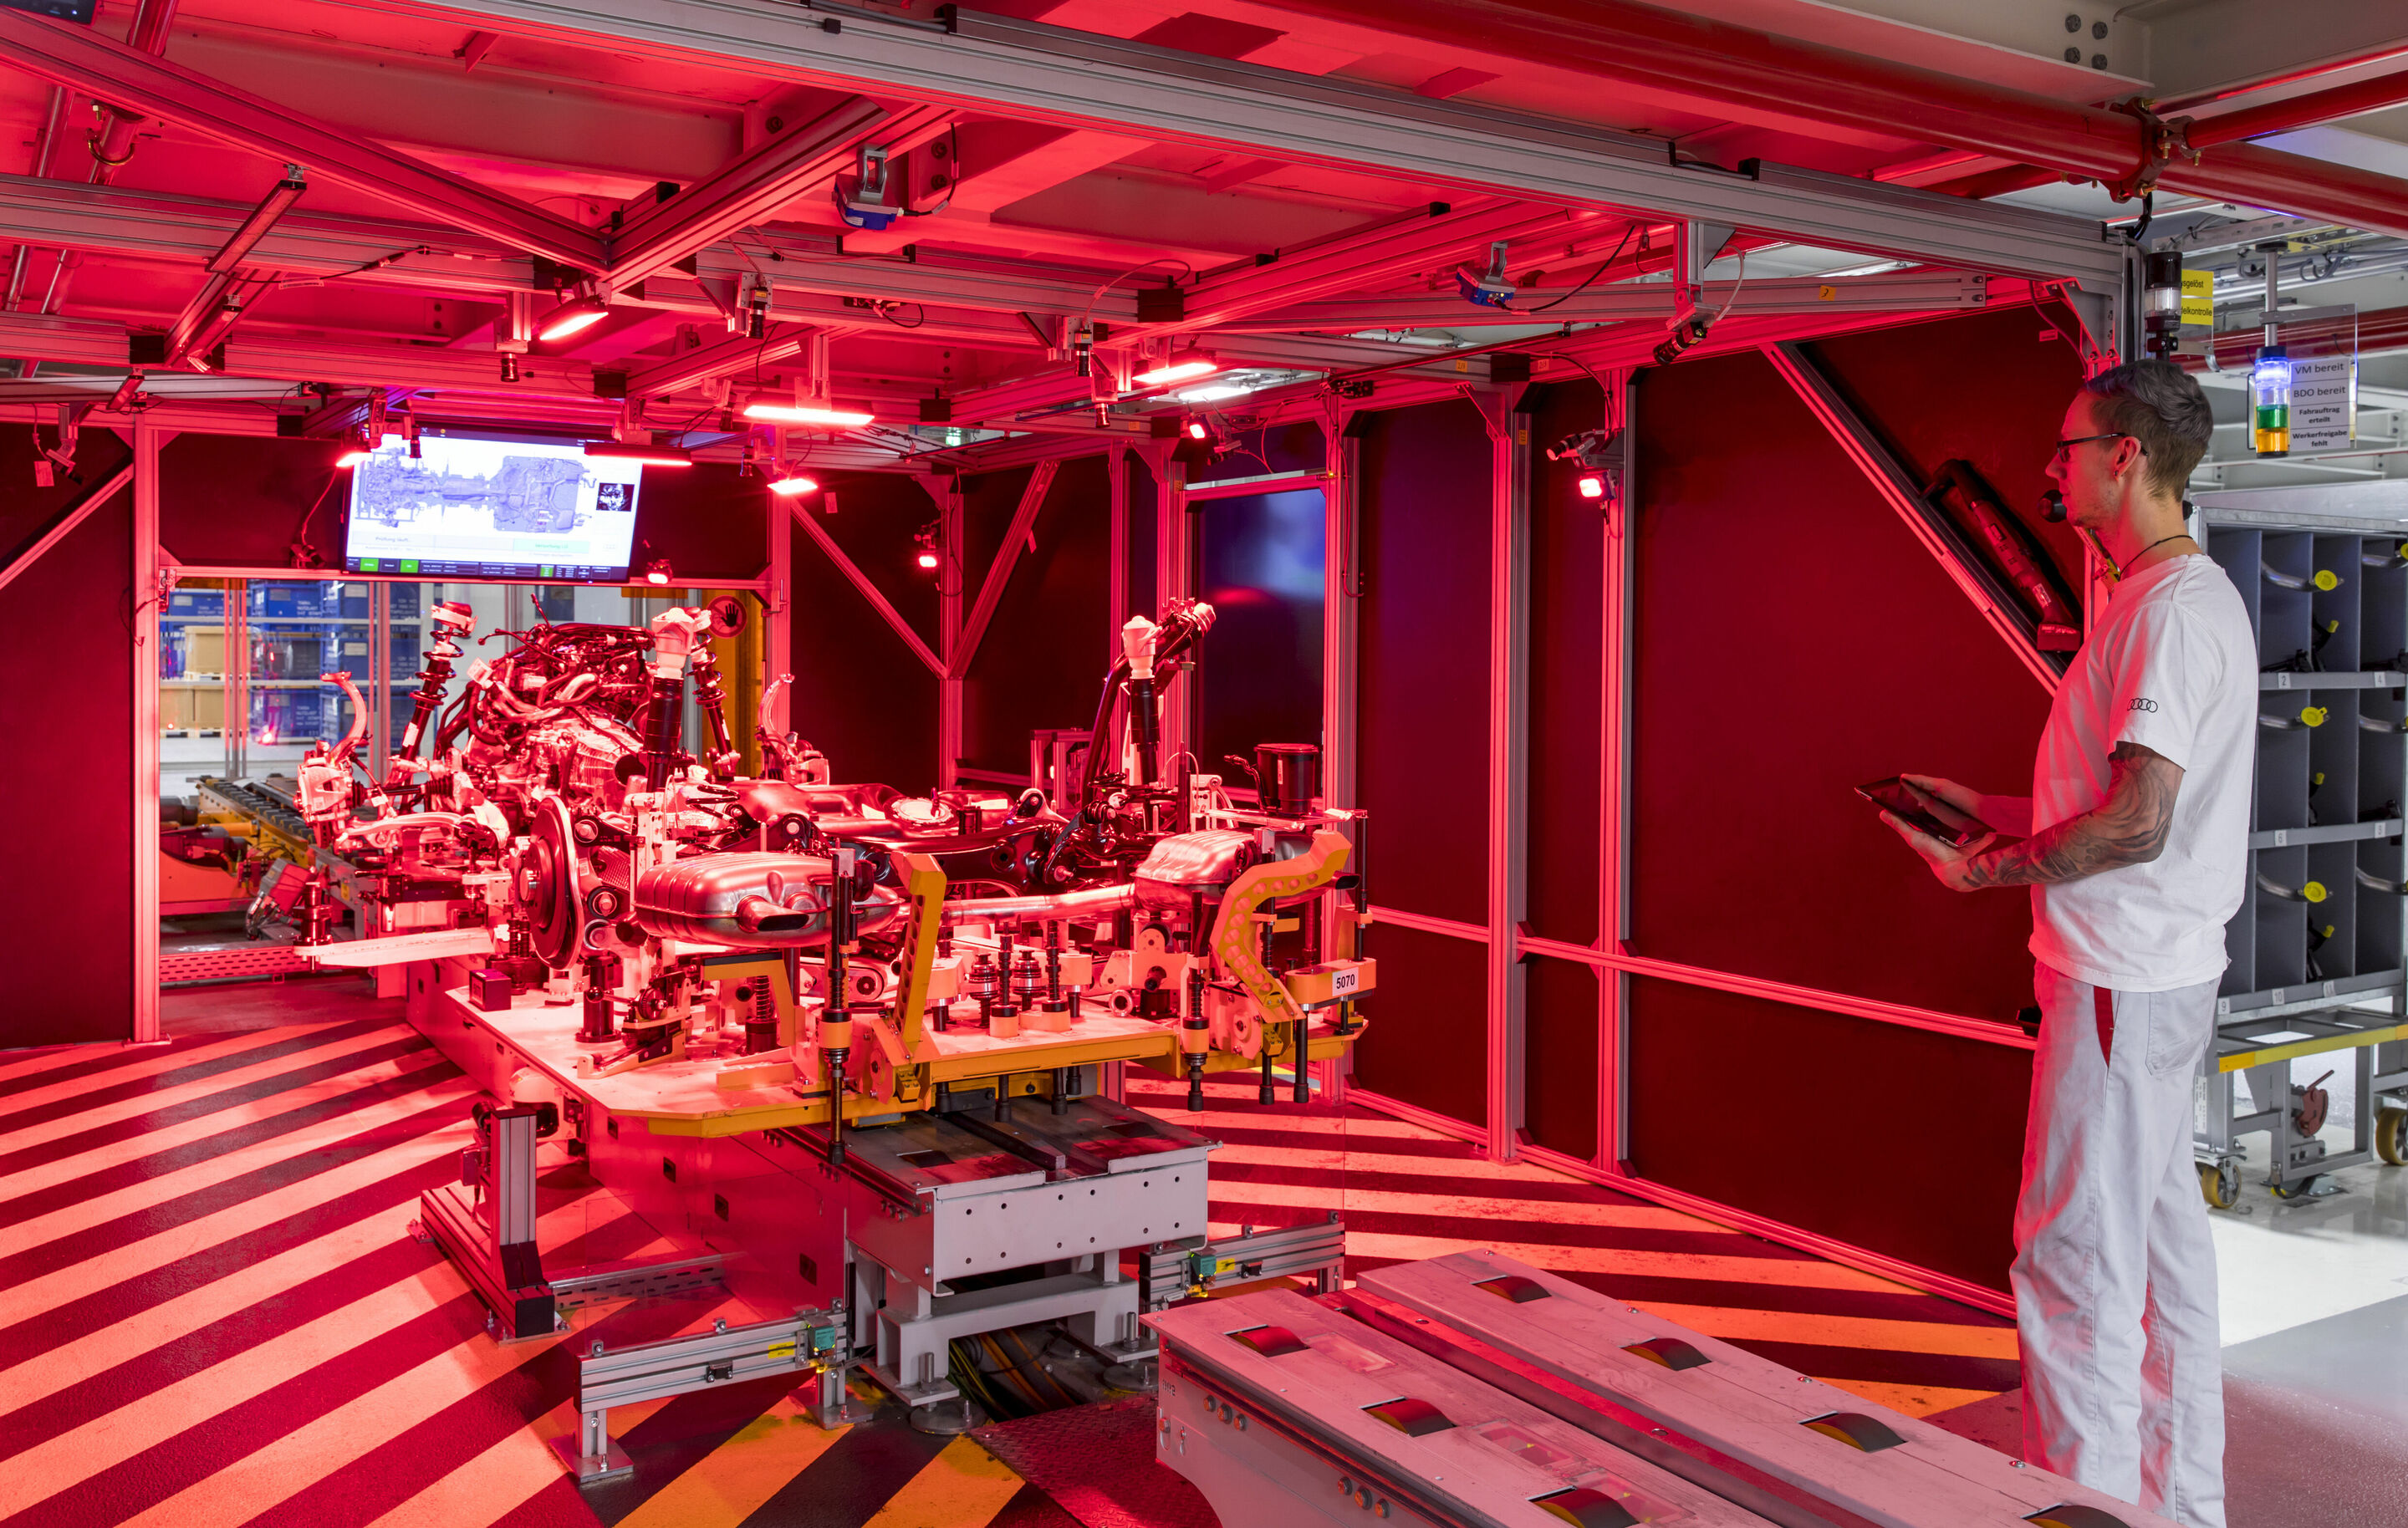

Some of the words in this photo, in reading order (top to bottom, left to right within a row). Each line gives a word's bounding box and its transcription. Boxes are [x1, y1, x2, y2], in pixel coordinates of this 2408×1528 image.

[2181, 279, 2204, 289] sgelöst
[2294, 366, 2312, 374] VM
[2314, 363, 2344, 373] bereit
[2293, 389, 2315, 398] BDO
[2317, 386, 2346, 395] bereit
[2299, 407, 2340, 415] Fahrauftrag
[2293, 430, 2348, 440] Werkerfreigabe
[2281, 675, 2287, 686] 2
[1336, 974, 1355, 989] 5070
[2274, 992, 2283, 1002] 10
[2222, 1001, 2227, 1012] 9
